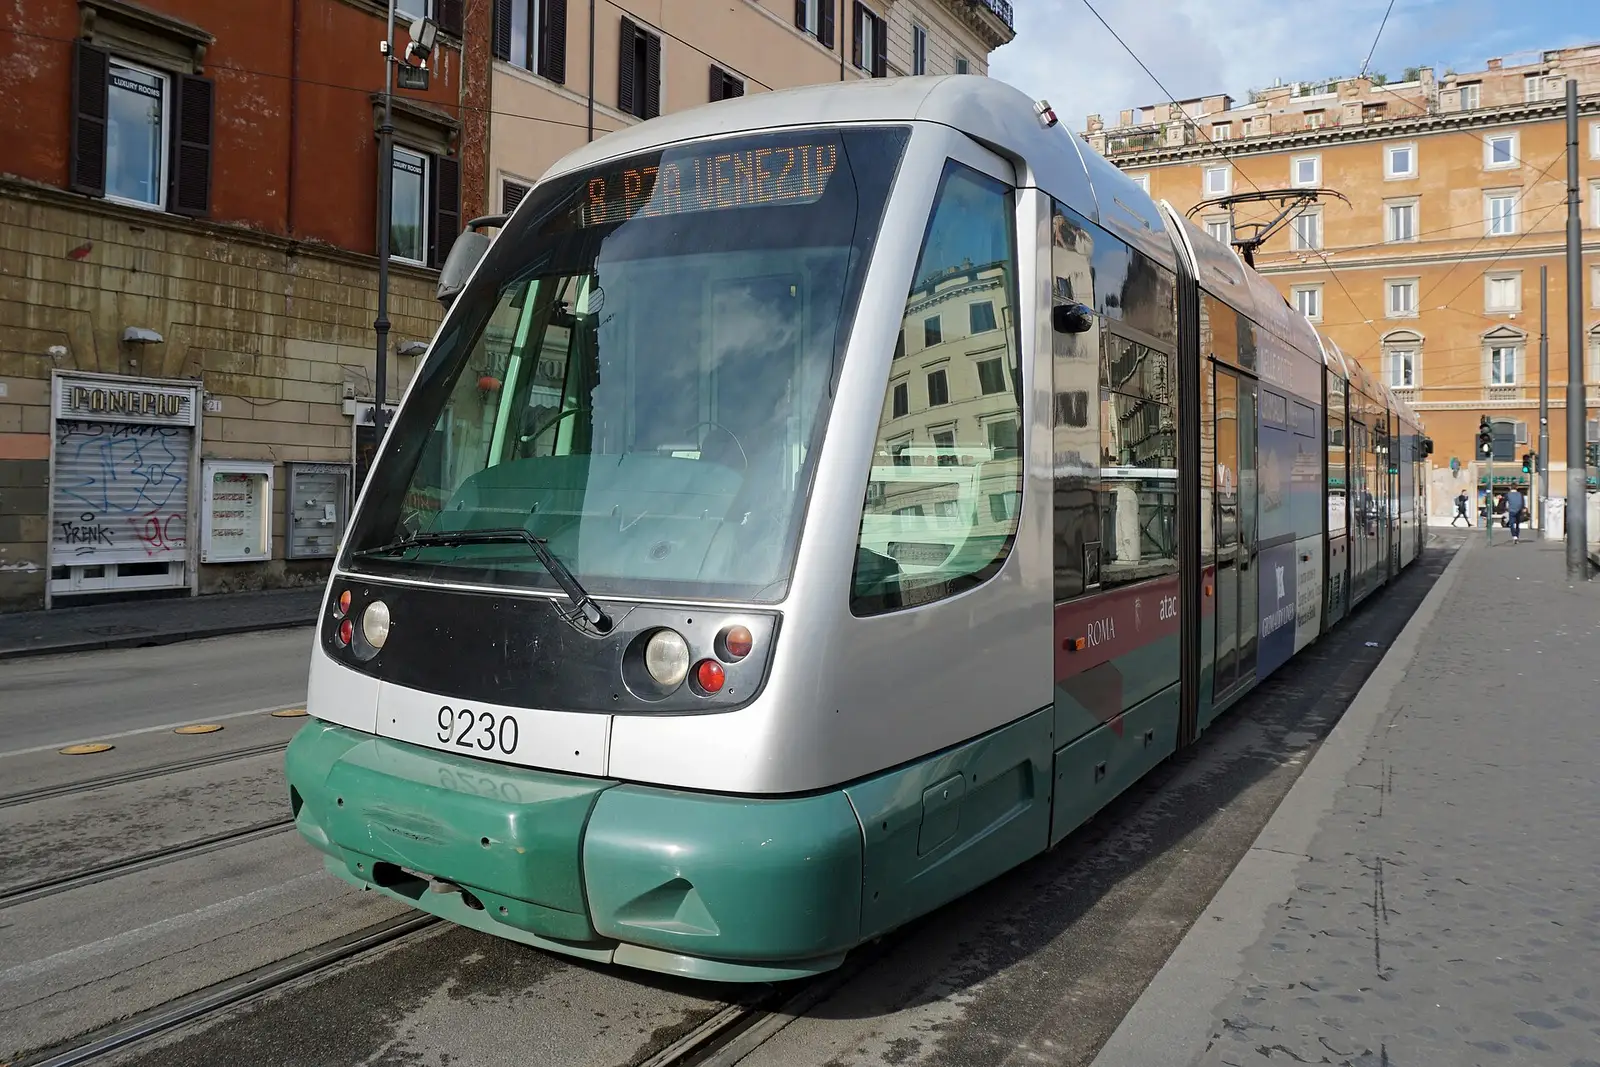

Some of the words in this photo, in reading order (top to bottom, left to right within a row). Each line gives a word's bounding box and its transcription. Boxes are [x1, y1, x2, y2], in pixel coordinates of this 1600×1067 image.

[114, 77, 137, 90] LUXURY
[139, 84, 160, 96] ROOMS
[1159, 595, 1177, 620] atac
[1087, 617, 1115, 648] ROMA
[437, 705, 519, 755] 9230
